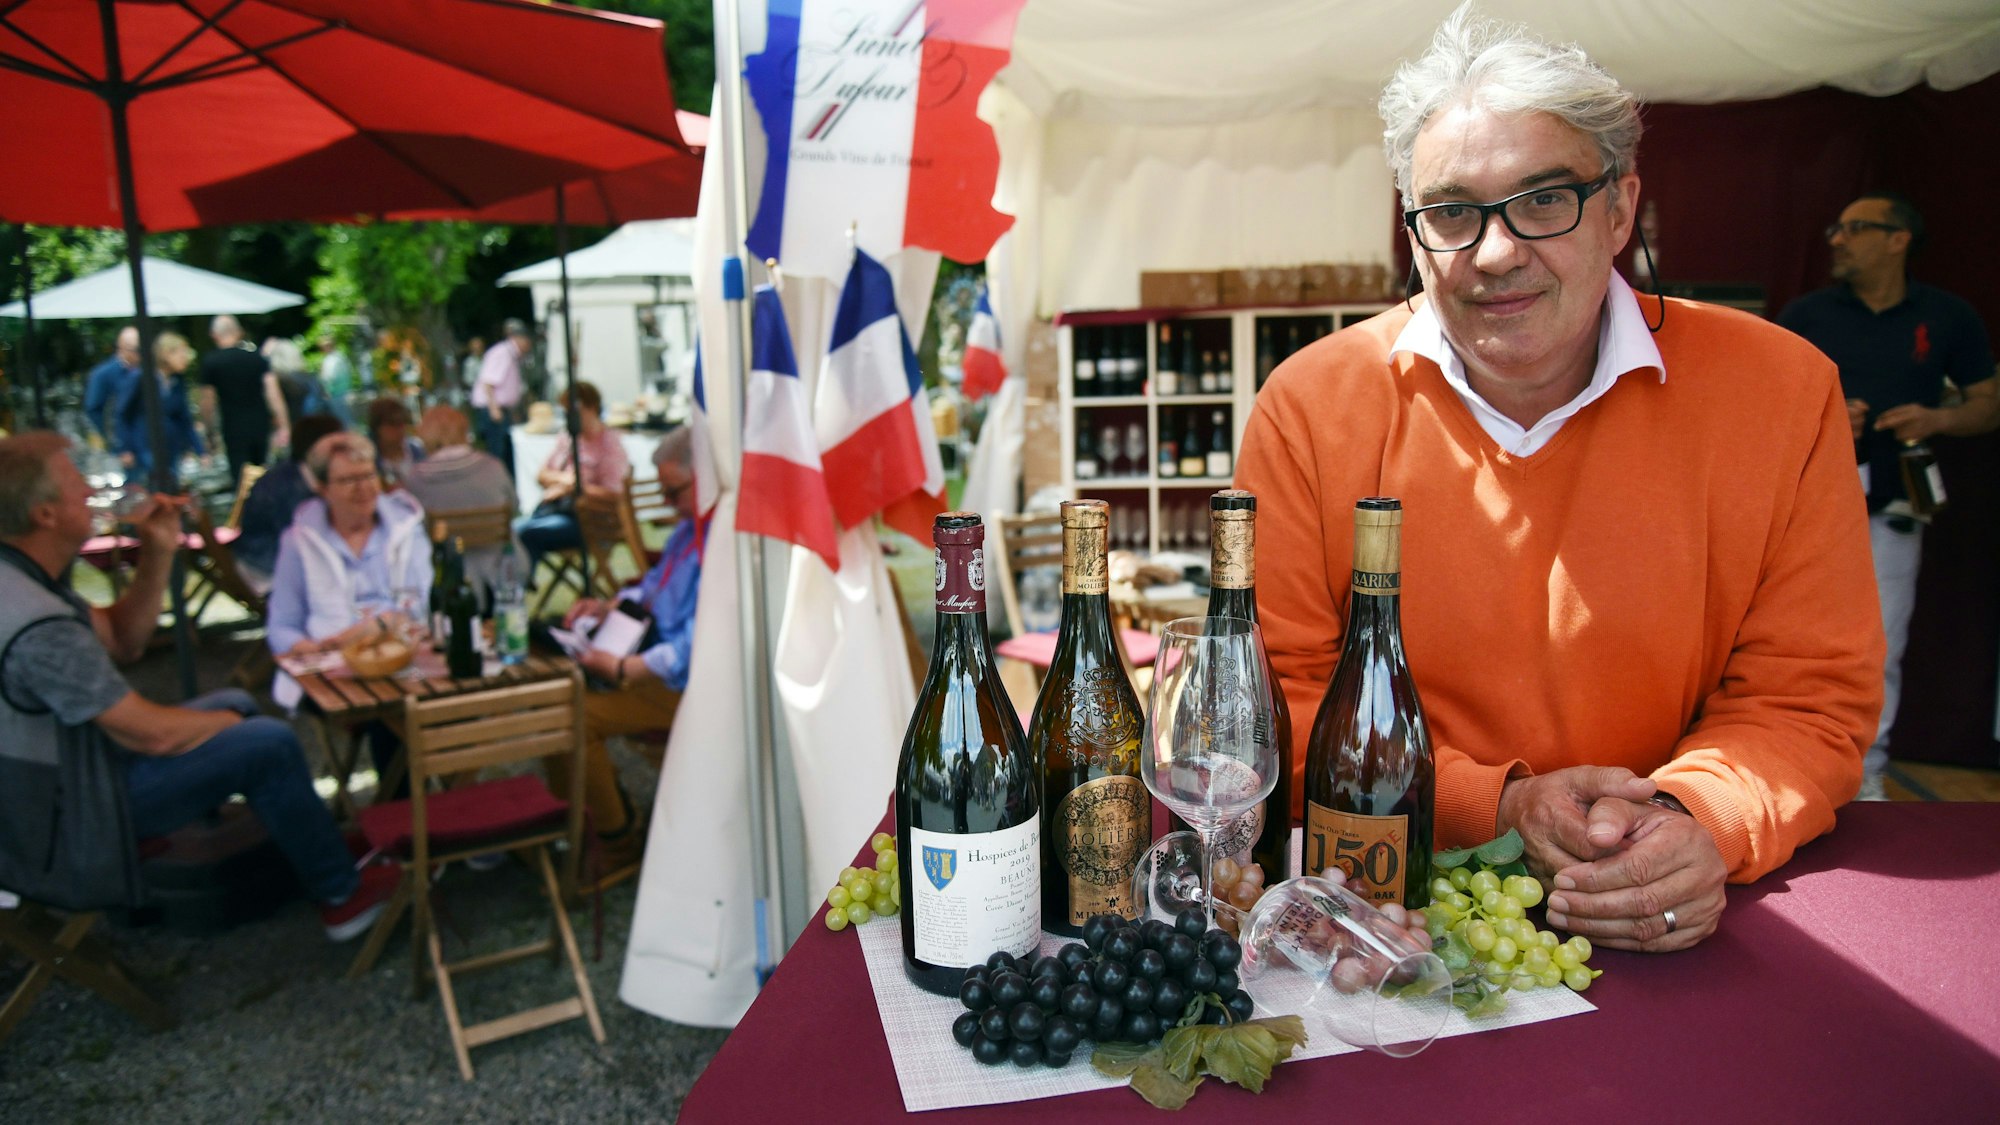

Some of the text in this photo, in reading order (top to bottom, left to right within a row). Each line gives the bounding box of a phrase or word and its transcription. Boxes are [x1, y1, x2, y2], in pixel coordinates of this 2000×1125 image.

[1353, 570, 1393, 588] BARIK
[968, 848, 1017, 865] Hospices
[1019, 838, 1029, 852] de
[1010, 853, 1031, 868] 2019
[1310, 833, 1399, 887] 150
